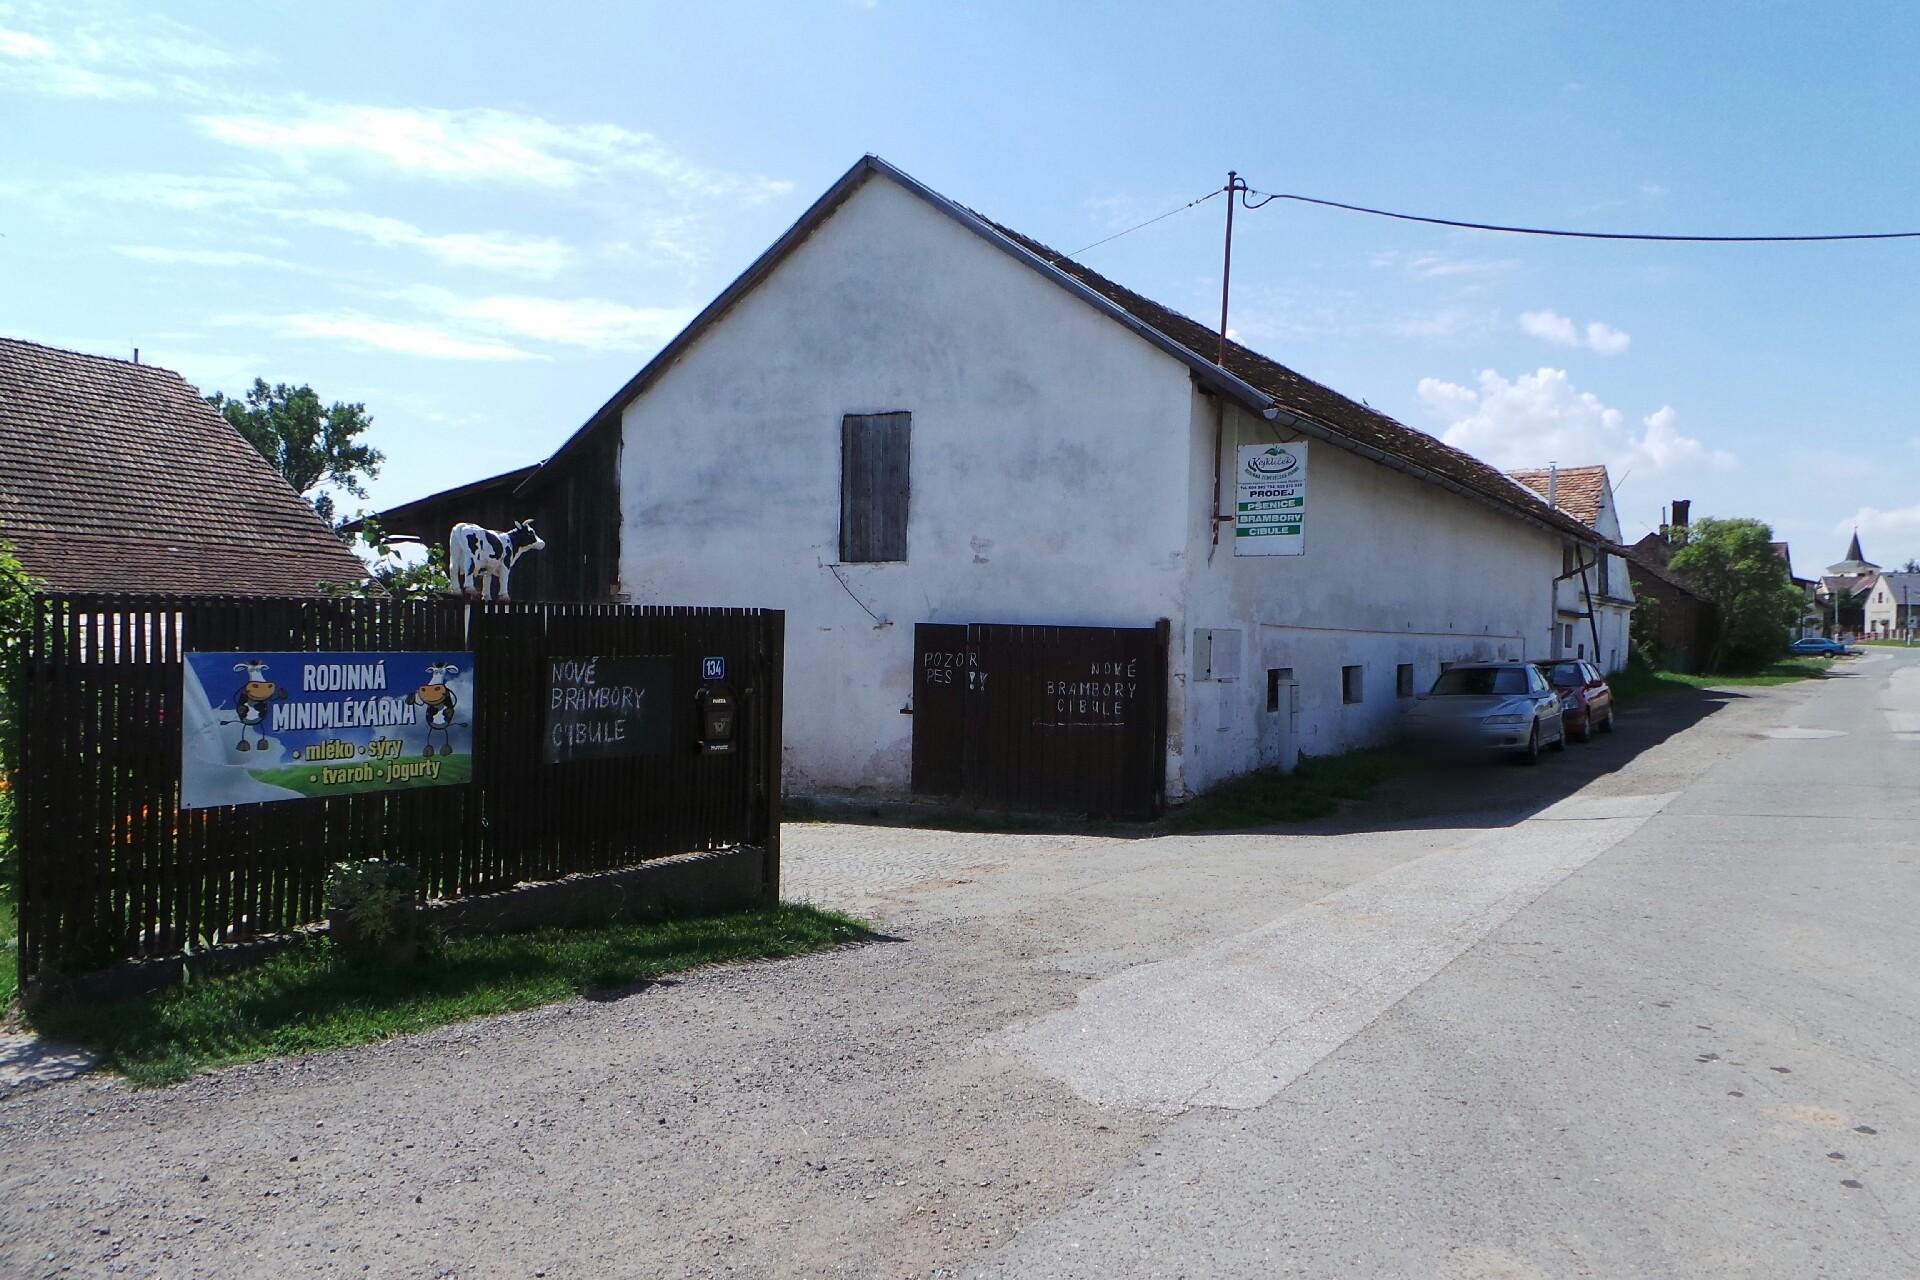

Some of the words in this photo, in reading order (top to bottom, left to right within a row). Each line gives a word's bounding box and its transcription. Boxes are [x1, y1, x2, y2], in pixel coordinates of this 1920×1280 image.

[1249, 489, 1295, 498] PRODEJ
[1247, 499, 1296, 511] PŠENICE
[1239, 514, 1301, 523] BRAMBORY
[1248, 527, 1289, 536] CIBULE
[552, 656, 600, 684] NOVÉ
[706, 660, 721, 676] 134
[924, 652, 978, 668] POZOR
[1091, 658, 1137, 678] NOVÉ
[303, 660, 387, 692] RODINNÁ
[926, 668, 953, 684] PES
[551, 686, 646, 710] BRAMBORY
[1047, 681, 1137, 699] BRAMBORY
[272, 696, 417, 731] MINIMLÉKÁRNA
[1057, 699, 1122, 716] CIBULE
[552, 720, 626, 746] CIBULE
[305, 738, 355, 761] mléko
[367, 736, 404, 760] sýry
[322, 762, 374, 785] tvaroh
[385, 760, 442, 784] jogurty
